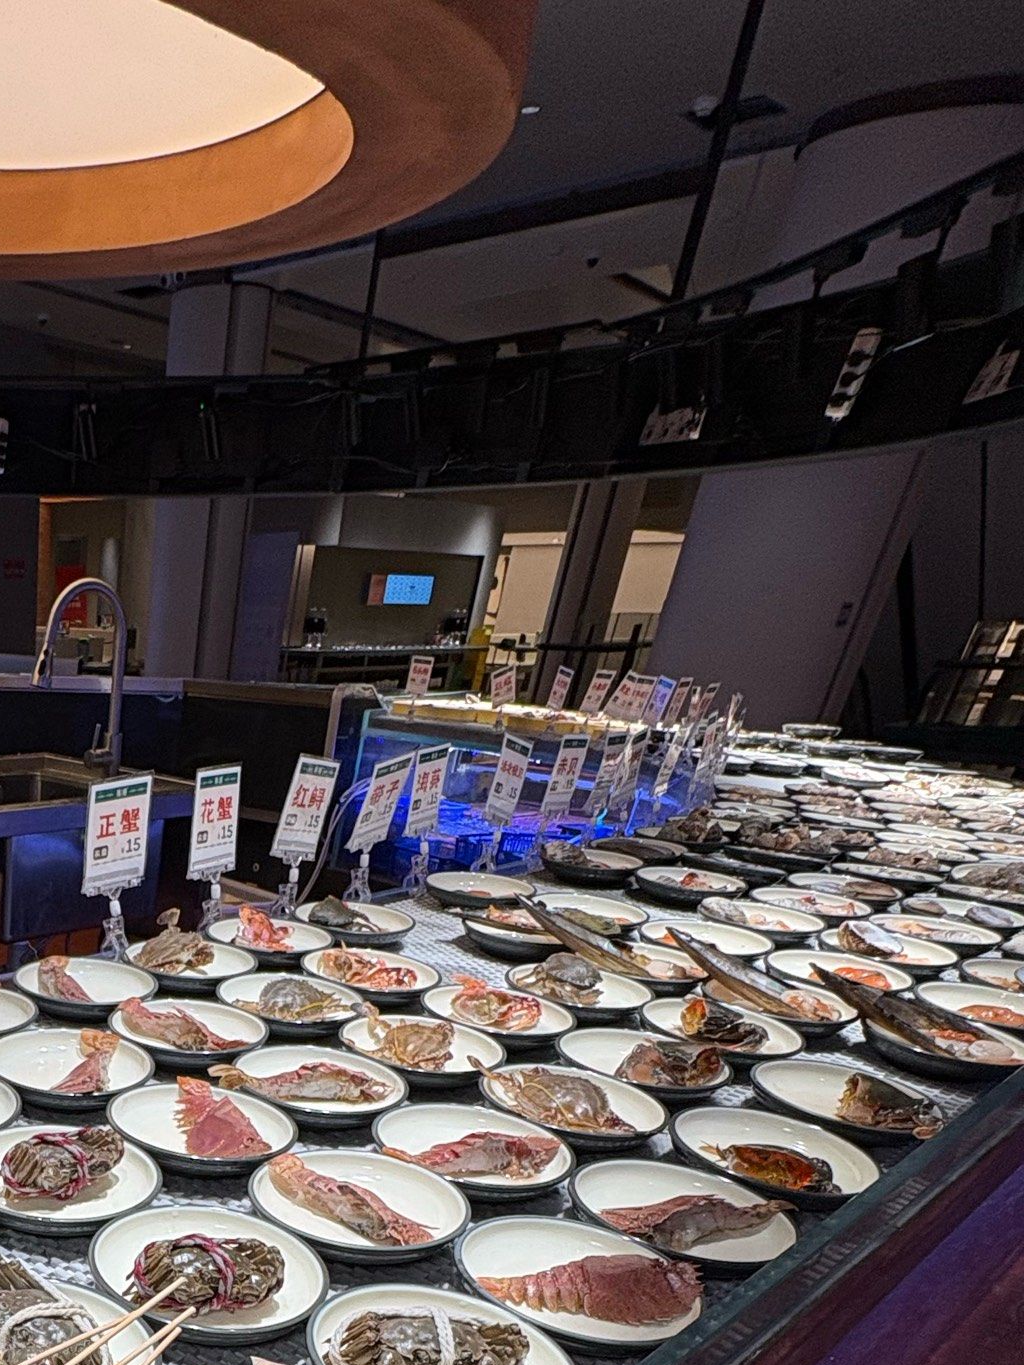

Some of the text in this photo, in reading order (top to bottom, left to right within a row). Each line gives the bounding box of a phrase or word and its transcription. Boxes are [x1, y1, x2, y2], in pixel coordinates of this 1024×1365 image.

[291, 784, 327, 811] 红鲟
[370, 779, 400, 806] 带子
[96, 807, 140, 840] 正蟹
[201, 796, 233, 824] 花蟹
